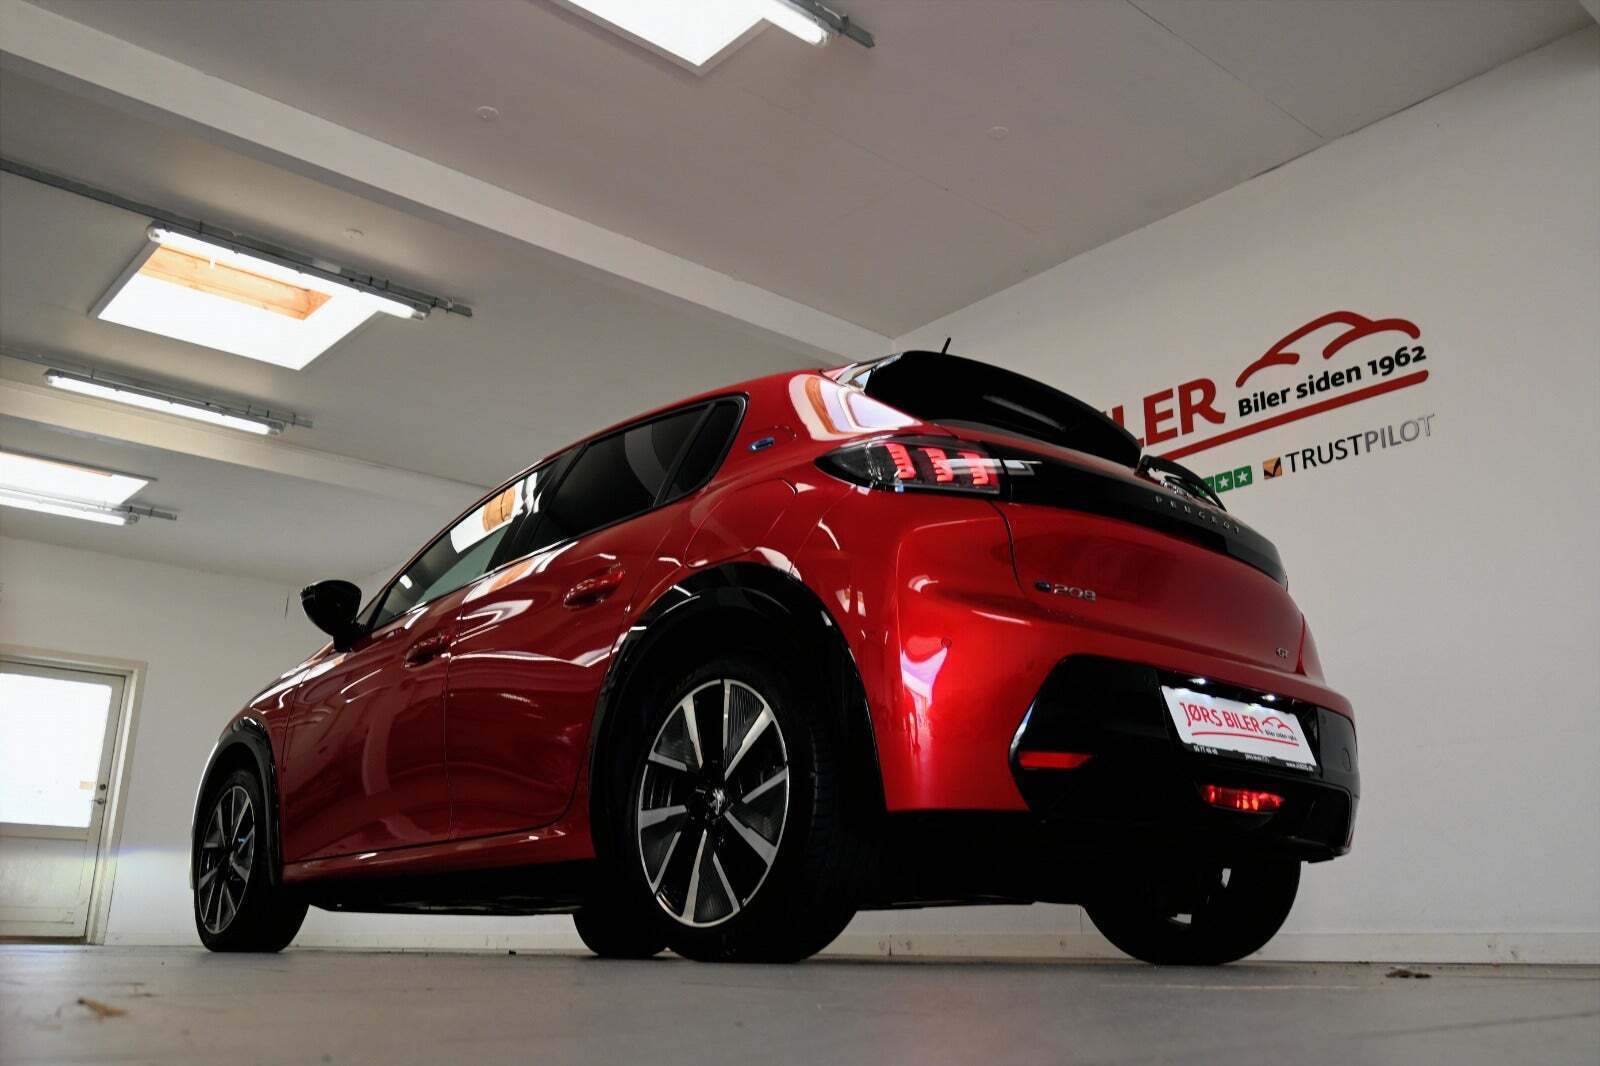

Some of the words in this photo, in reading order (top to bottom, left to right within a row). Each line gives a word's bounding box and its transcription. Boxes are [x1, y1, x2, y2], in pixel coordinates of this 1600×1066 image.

[1238, 388, 1290, 417] Biler
[1296, 365, 1361, 399] siden
[1367, 346, 1427, 377] 1962
[1285, 413, 1435, 473] TRUSTPILOT
[1179, 702, 1223, 727] JØRS
[1221, 711, 1264, 734] BILER
